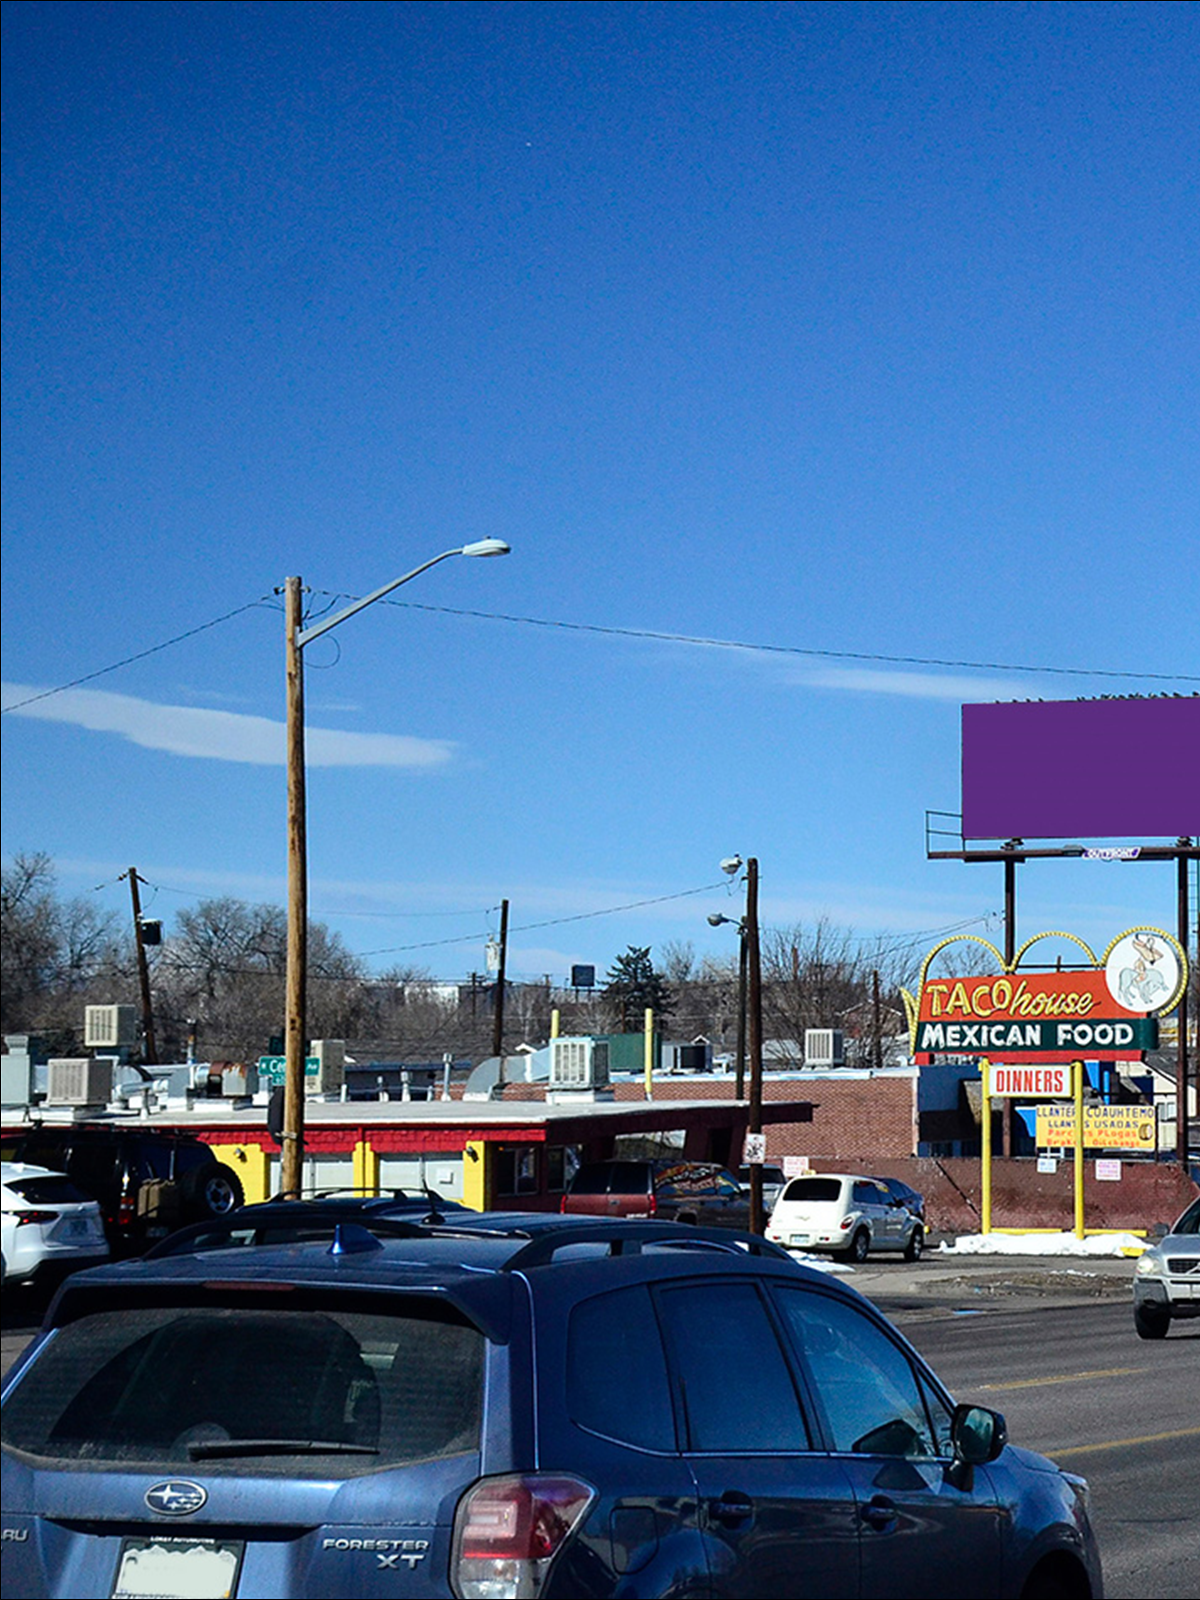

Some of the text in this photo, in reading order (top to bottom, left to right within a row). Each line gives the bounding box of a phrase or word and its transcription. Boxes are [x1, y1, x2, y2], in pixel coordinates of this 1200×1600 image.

[925, 979, 1102, 1017] TACO house
[921, 1023, 1134, 1050] MEXICAN FOOD
[995, 1070, 1064, 1093] DINNERS
[1036, 1107, 1082, 1118] LLANTER
[1048, 1120, 1139, 1129] LLANTS USADAS
[1, 1529, 28, 1541] RU
[323, 1539, 429, 1550] FORESTER
[377, 1554, 425, 1569] XT
